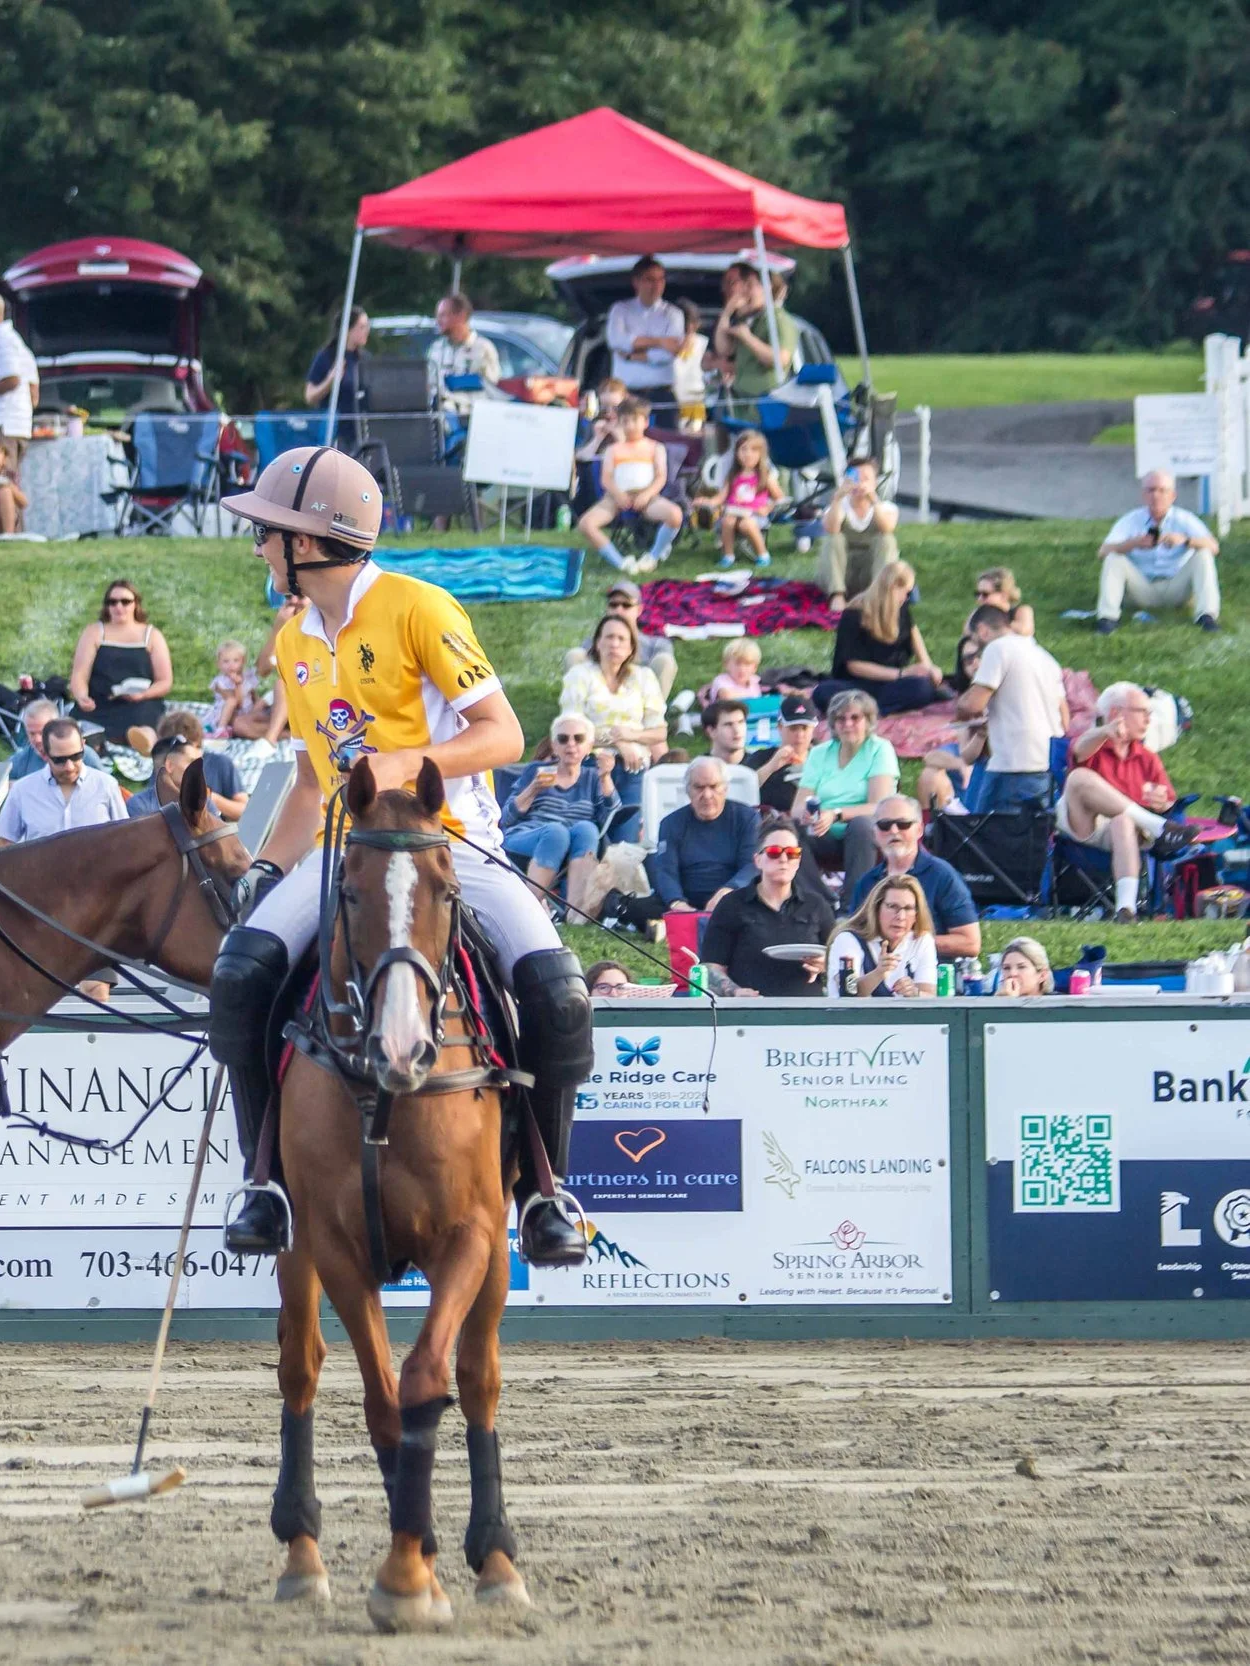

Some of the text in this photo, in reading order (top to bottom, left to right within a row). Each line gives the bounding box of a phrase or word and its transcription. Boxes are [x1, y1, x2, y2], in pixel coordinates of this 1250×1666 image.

[311, 502, 328, 512] AF
[610, 1071, 666, 1085] Ridge
[672, 1071, 717, 1083] Care
[781, 1072, 908, 1086] SENIOR LIVING
[1153, 1070, 1249, 1102] Bank
[603, 1091, 644, 1100] YEARS
[805, 1096, 888, 1108] NORTHFAX
[603, 1101, 704, 1109] CARING FOR LIF
[805, 1159, 932, 1174] FALCONS LANDING
[563, 1170, 739, 1186] artners in care
[70, 1193, 147, 1206] MADE
[773, 1252, 924, 1270] SPRING ARBOR
[583, 1273, 731, 1289] REFLECTIONS
[759, 1288, 794, 1296] Leading
[797, 1287, 816, 1295] with
[846, 1287, 883, 1295] Because
